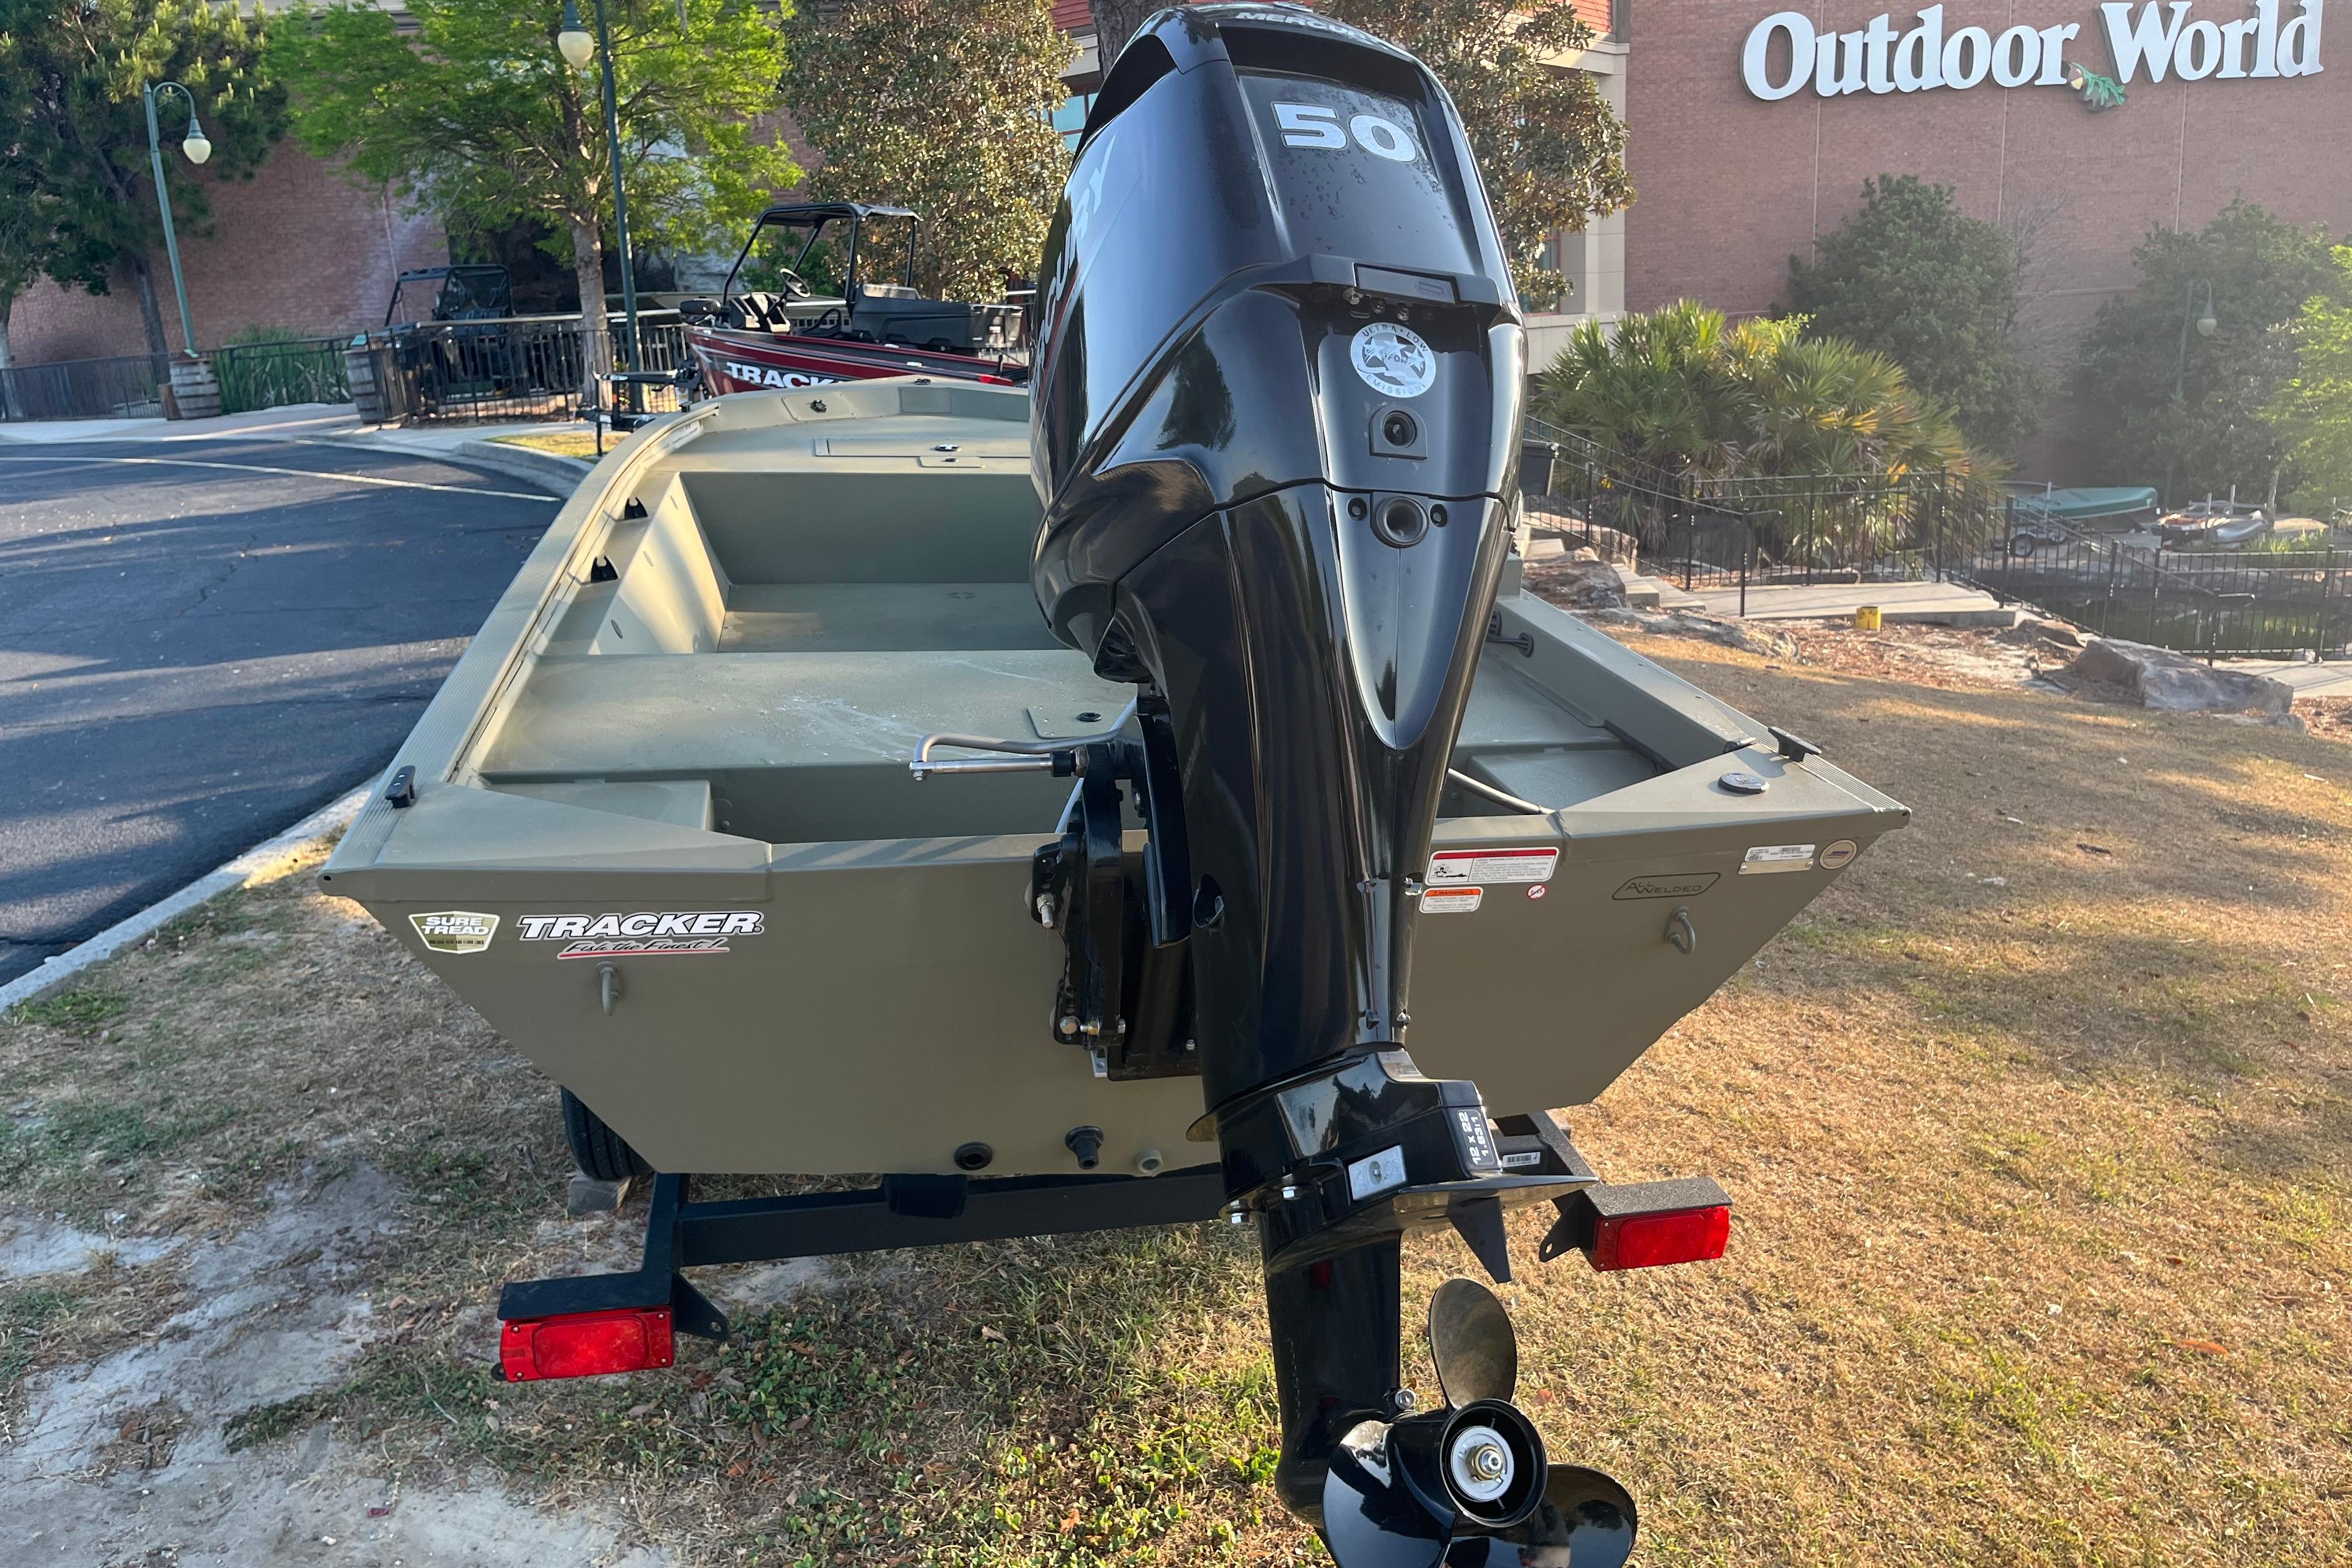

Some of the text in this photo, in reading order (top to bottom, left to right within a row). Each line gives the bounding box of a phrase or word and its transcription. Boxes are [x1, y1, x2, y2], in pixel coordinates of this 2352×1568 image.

[1236, 11, 1378, 46] MERCUR
[1742, 0, 2324, 101] Outdoor World
[1273, 103, 1417, 163] 50
[1362, 324, 1429, 352] ULTRA LOW
[1624, 881, 1655, 891] ALL
[1636, 885, 1702, 894] WELDED
[421, 925, 490, 935] TREAD
[425, 916, 484, 926] SURE
[520, 912, 761, 939] TRACKER
[566, 941, 607, 953] Fish
[612, 940, 641, 951] the
[1458, 1111, 1473, 1133] 22
[1470, 1116, 1490, 1157] 1.83:1
[1469, 1146, 1482, 1166] 12
